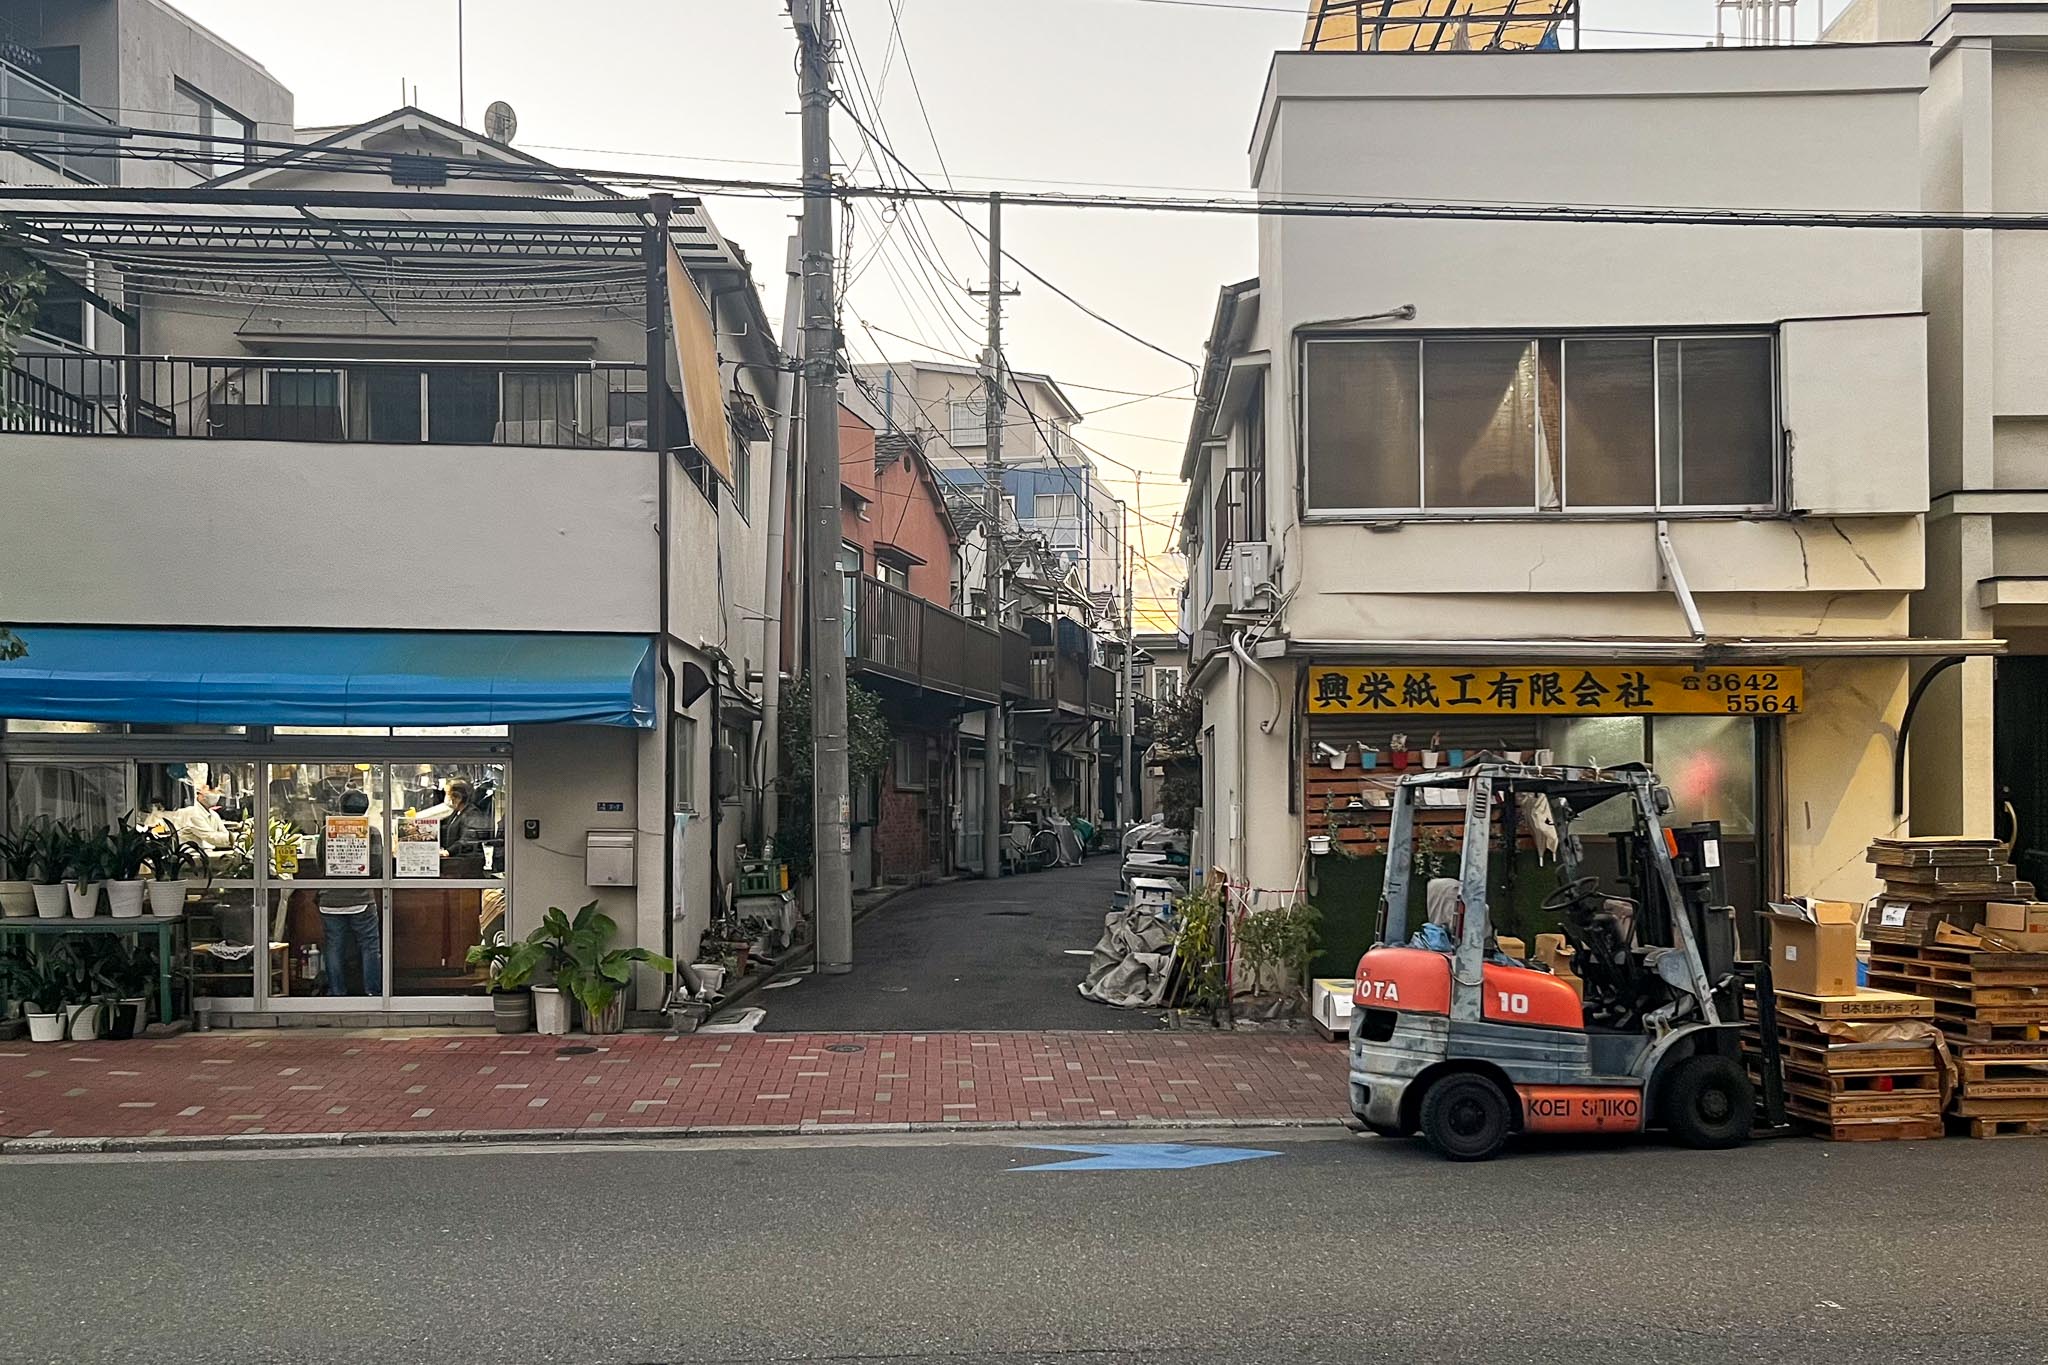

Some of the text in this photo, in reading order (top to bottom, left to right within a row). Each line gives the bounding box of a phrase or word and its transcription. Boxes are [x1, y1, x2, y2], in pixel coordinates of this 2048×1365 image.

[1314, 671, 1654, 708] 興栄紙工有限会社
[1707, 674, 1779, 691] 3642
[1727, 694, 1799, 712] 5564
[1498, 991, 1529, 1014] 10
[1528, 1099, 1570, 1116] KOEI
